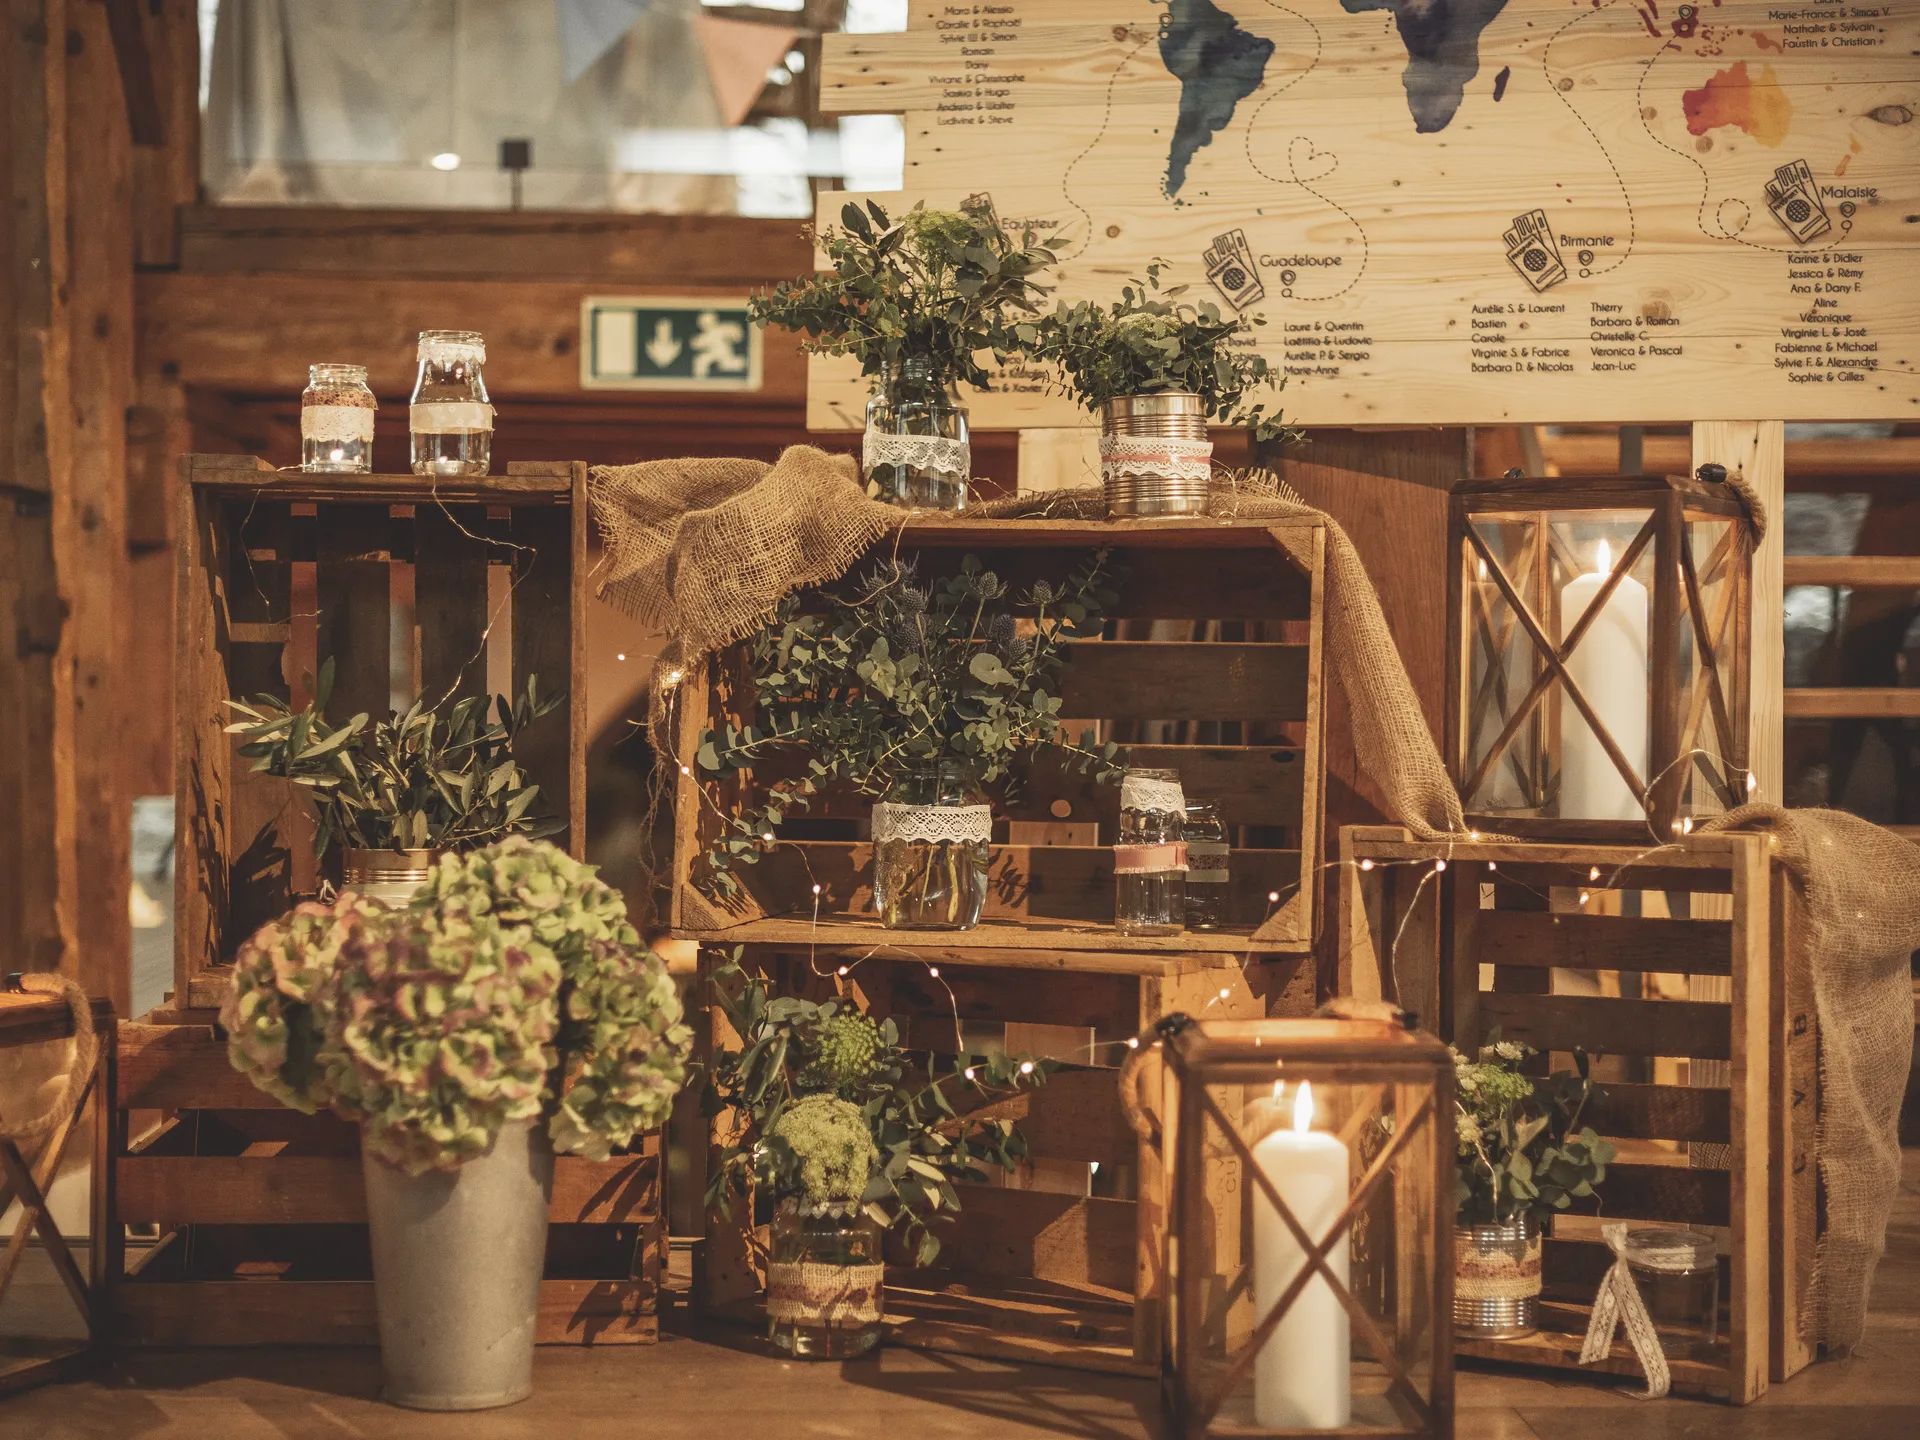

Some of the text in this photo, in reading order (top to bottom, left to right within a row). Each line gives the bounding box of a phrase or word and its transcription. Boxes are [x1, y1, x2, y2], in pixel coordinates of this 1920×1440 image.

[1768, 9, 1836, 20] Marie-France
[1839, 8, 1847, 17] &
[1882, 7, 1891, 16] V.
[1783, 22, 1875, 34] Nathalie & Sylvain
[1782, 37, 1876, 48] Faustin & Christian
[1820, 185, 1878, 199] Malaisie
[1560, 234, 1614, 247] Birmanie
[1259, 254, 1342, 268] Guadeloupe
[1787, 253, 1863, 263] Karine & Didier
[1787, 267, 1864, 280] Jessica & Rémy
[1790, 283, 1862, 295] Ana & Dany F.
[1472, 303, 1565, 314] Aurélie S. & Laurent
[1590, 303, 1623, 314] Thierry
[1813, 298, 1838, 308] Aline
[1590, 316, 1680, 327] Barbara & Roman
[1799, 312, 1852, 324] Véronique
[1284, 321, 1364, 332] Laure & Quentin
[1471, 319, 1507, 329] Bastien
[1471, 334, 1506, 343] Carole
[1590, 332, 1636, 341] Christelle
[1781, 328, 1819, 339] Virginie
[1832, 327, 1840, 337] &
[1843, 327, 1867, 337] José
[1284, 336, 1373, 346] Laëtitia & Ludovic
[1775, 341, 1878, 352] Fabienne & Michael
[1284, 351, 1370, 361] Aurélie P. & Sergio
[1471, 347, 1570, 358] Virginie S. & Fabrice
[1590, 346, 1683, 356] Veronica & Pascal
[1471, 362, 1574, 373] Barbara D. & Nicolas
[1590, 362, 1636, 371] Jean-Luc
[1774, 357, 1878, 369] Sylvie F. & Alexandre
[1284, 366, 1340, 376] Marie-Anne
[1787, 371, 1865, 384] Sophie & Gilles
